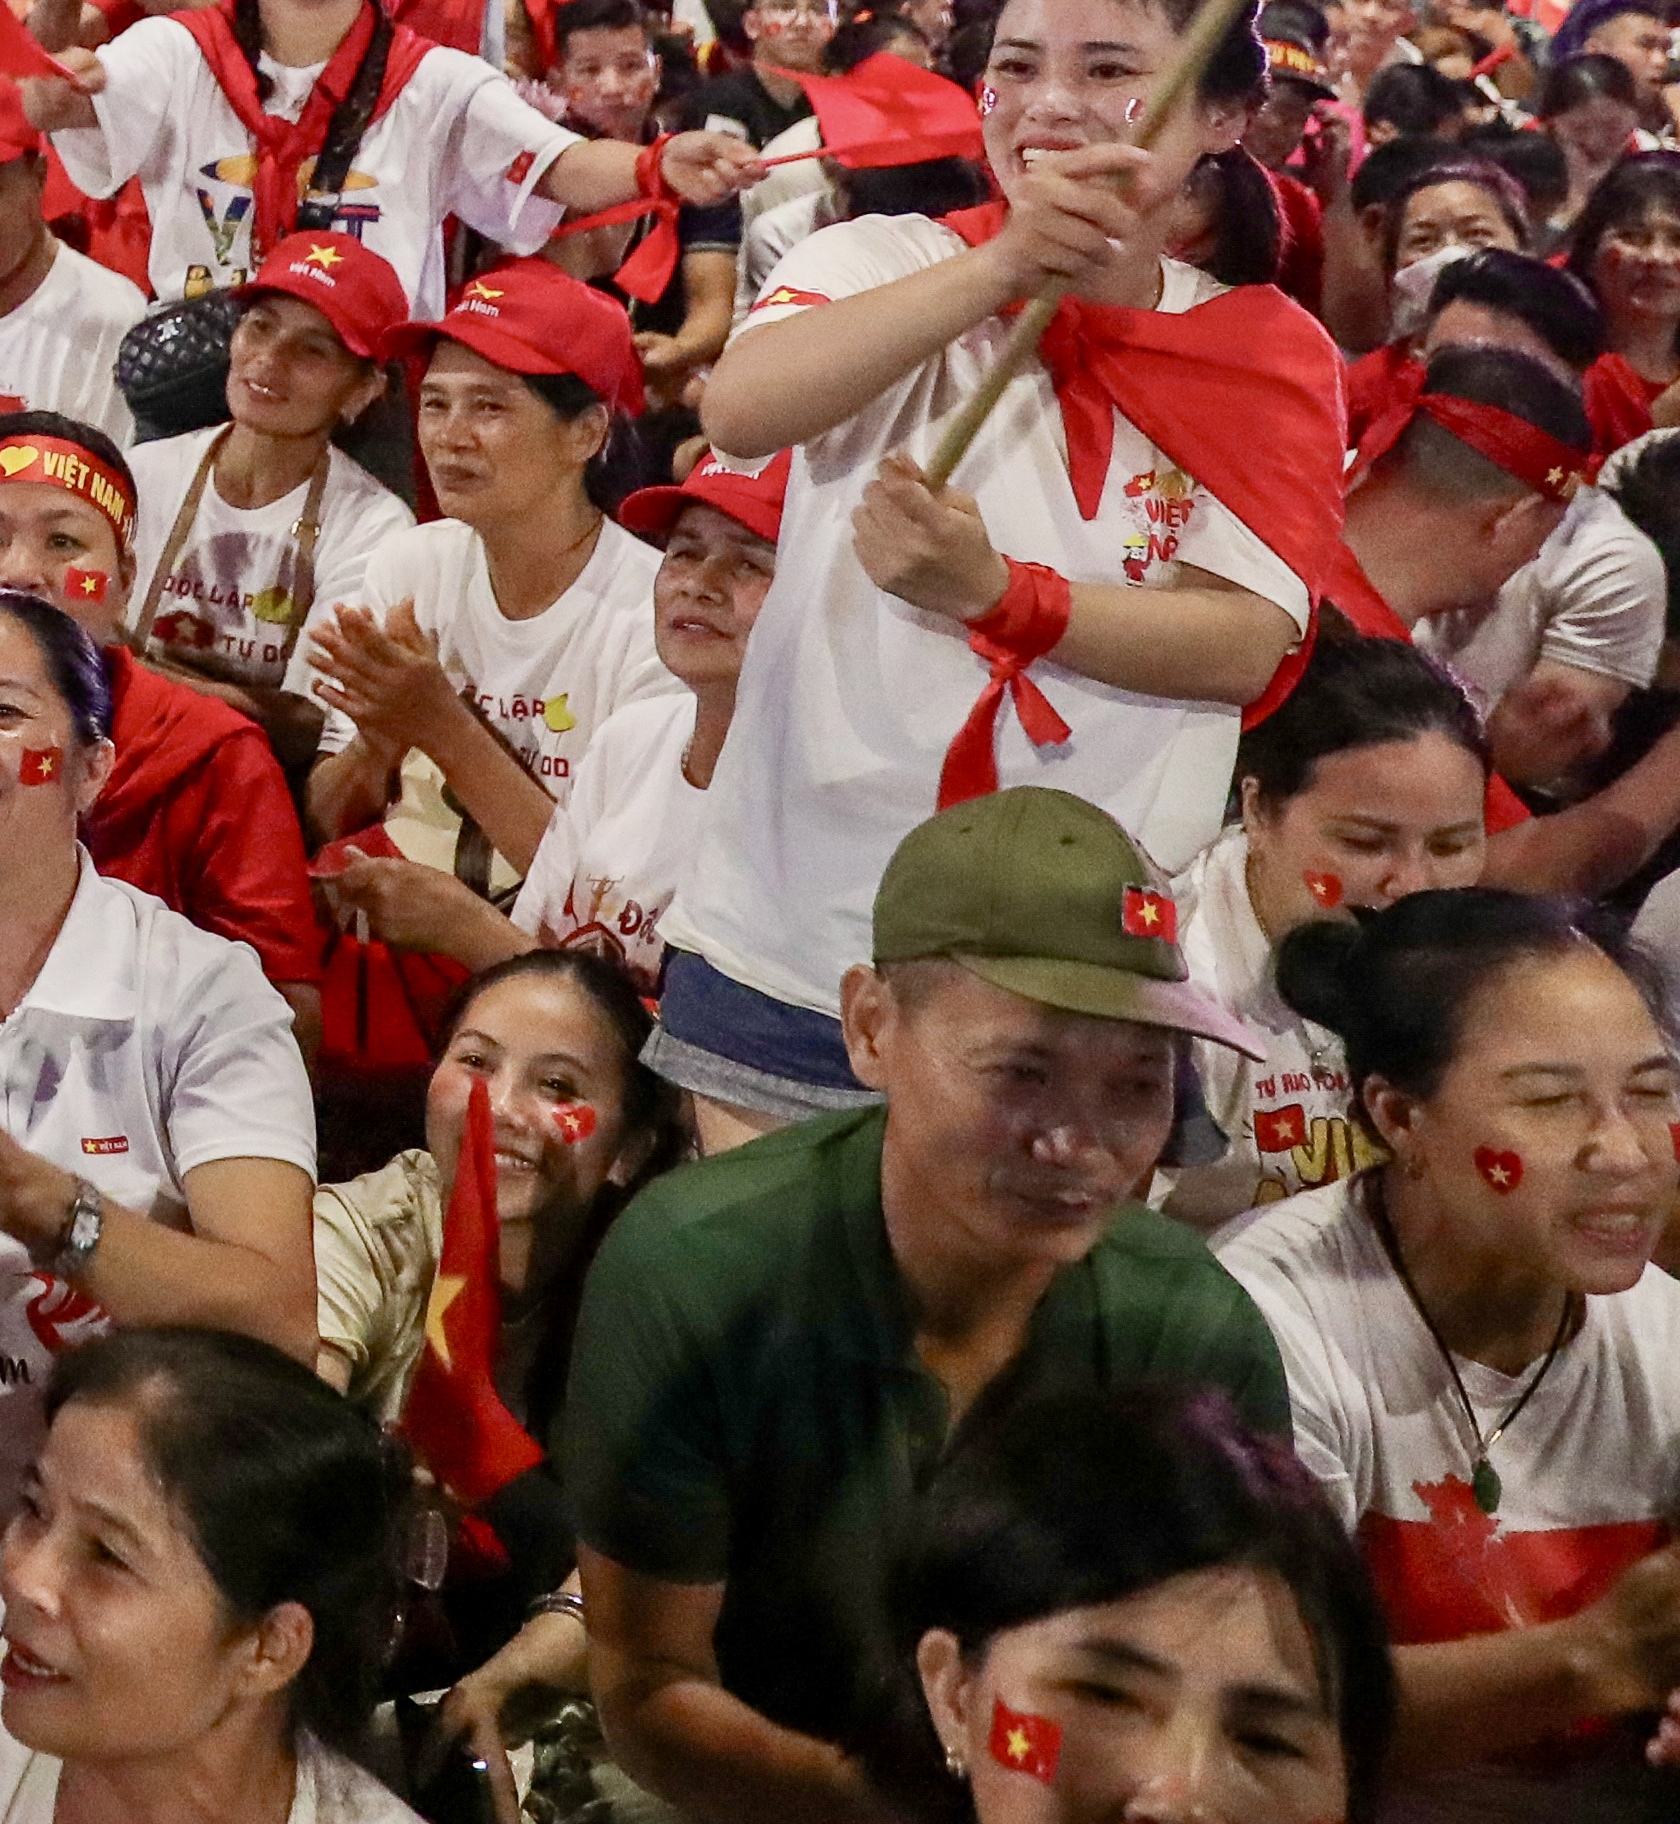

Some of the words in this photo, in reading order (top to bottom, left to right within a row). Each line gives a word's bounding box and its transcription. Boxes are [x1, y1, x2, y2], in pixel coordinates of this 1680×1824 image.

[43, 451, 89, 490] VIỆT
[90, 471, 125, 525] NAM
[500, 694, 545, 722] LẬP
[541, 756, 569, 777] DO
[617, 899, 659, 945] Độ
